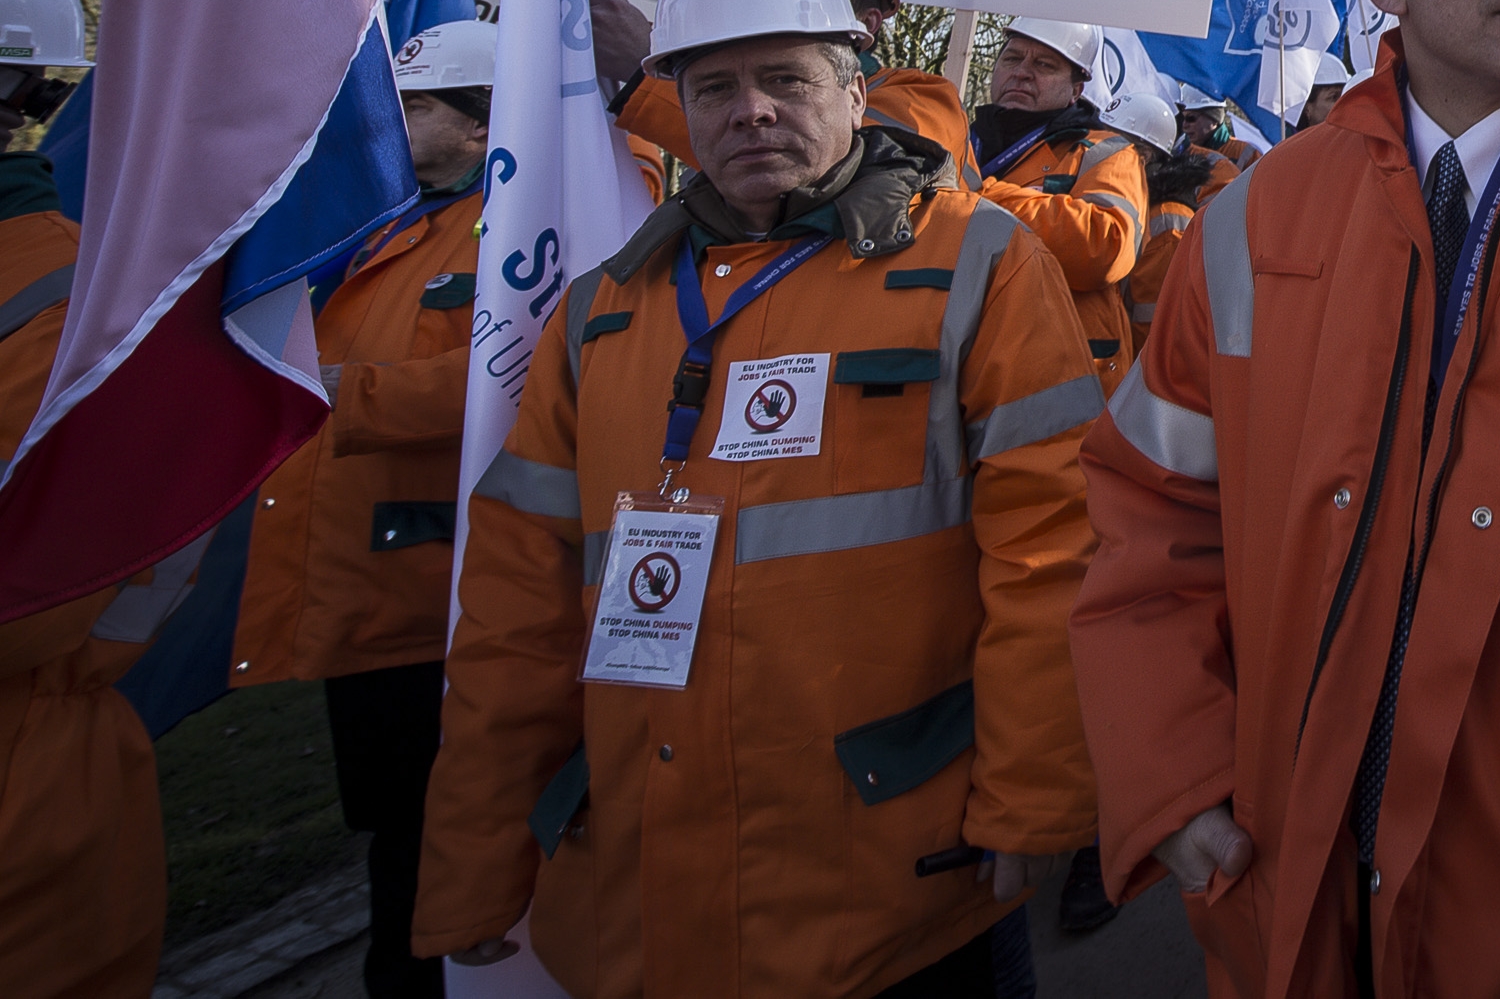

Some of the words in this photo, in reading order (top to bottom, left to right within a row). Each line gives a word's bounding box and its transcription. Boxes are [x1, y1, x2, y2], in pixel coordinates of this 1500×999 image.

[1483, 208, 1497, 233] FAIR
[1479, 233, 1488, 241] &
[1470, 243, 1484, 273] JOBS
[1465, 273, 1476, 288] TO
[1459, 291, 1471, 314] YES
[1453, 316, 1464, 336] SAY
[743, 364, 755, 372] EU
[757, 357, 794, 371] INDUSTRY
[796, 357, 814, 365] FOR
[738, 373, 760, 381] JOBS
[768, 369, 784, 378] FAIR
[787, 366, 816, 374] TRADE
[717, 443, 740, 452] STOP
[741, 439, 769, 449] CHINA
[771, 435, 816, 446] DUMPING
[726, 451, 749, 459] STOP
[751, 448, 779, 458] CHINA
[781, 446, 803, 454] MES
[628, 528, 640, 537] EU
[641, 529, 682, 539] INDUSTRY
[684, 531, 701, 540] FOR
[623, 538, 645, 547] JOBS
[646, 540, 652, 548] &
[654, 540, 673, 549] FAIR
[675, 541, 702, 550] TRADE
[599, 617, 622, 627] STOP
[623, 618, 651, 628] CHINA
[652, 620, 693, 631] DUMPING
[608, 628, 631, 638] STOP
[631, 629, 659, 640] CHINA
[661, 631, 680, 641] MES
